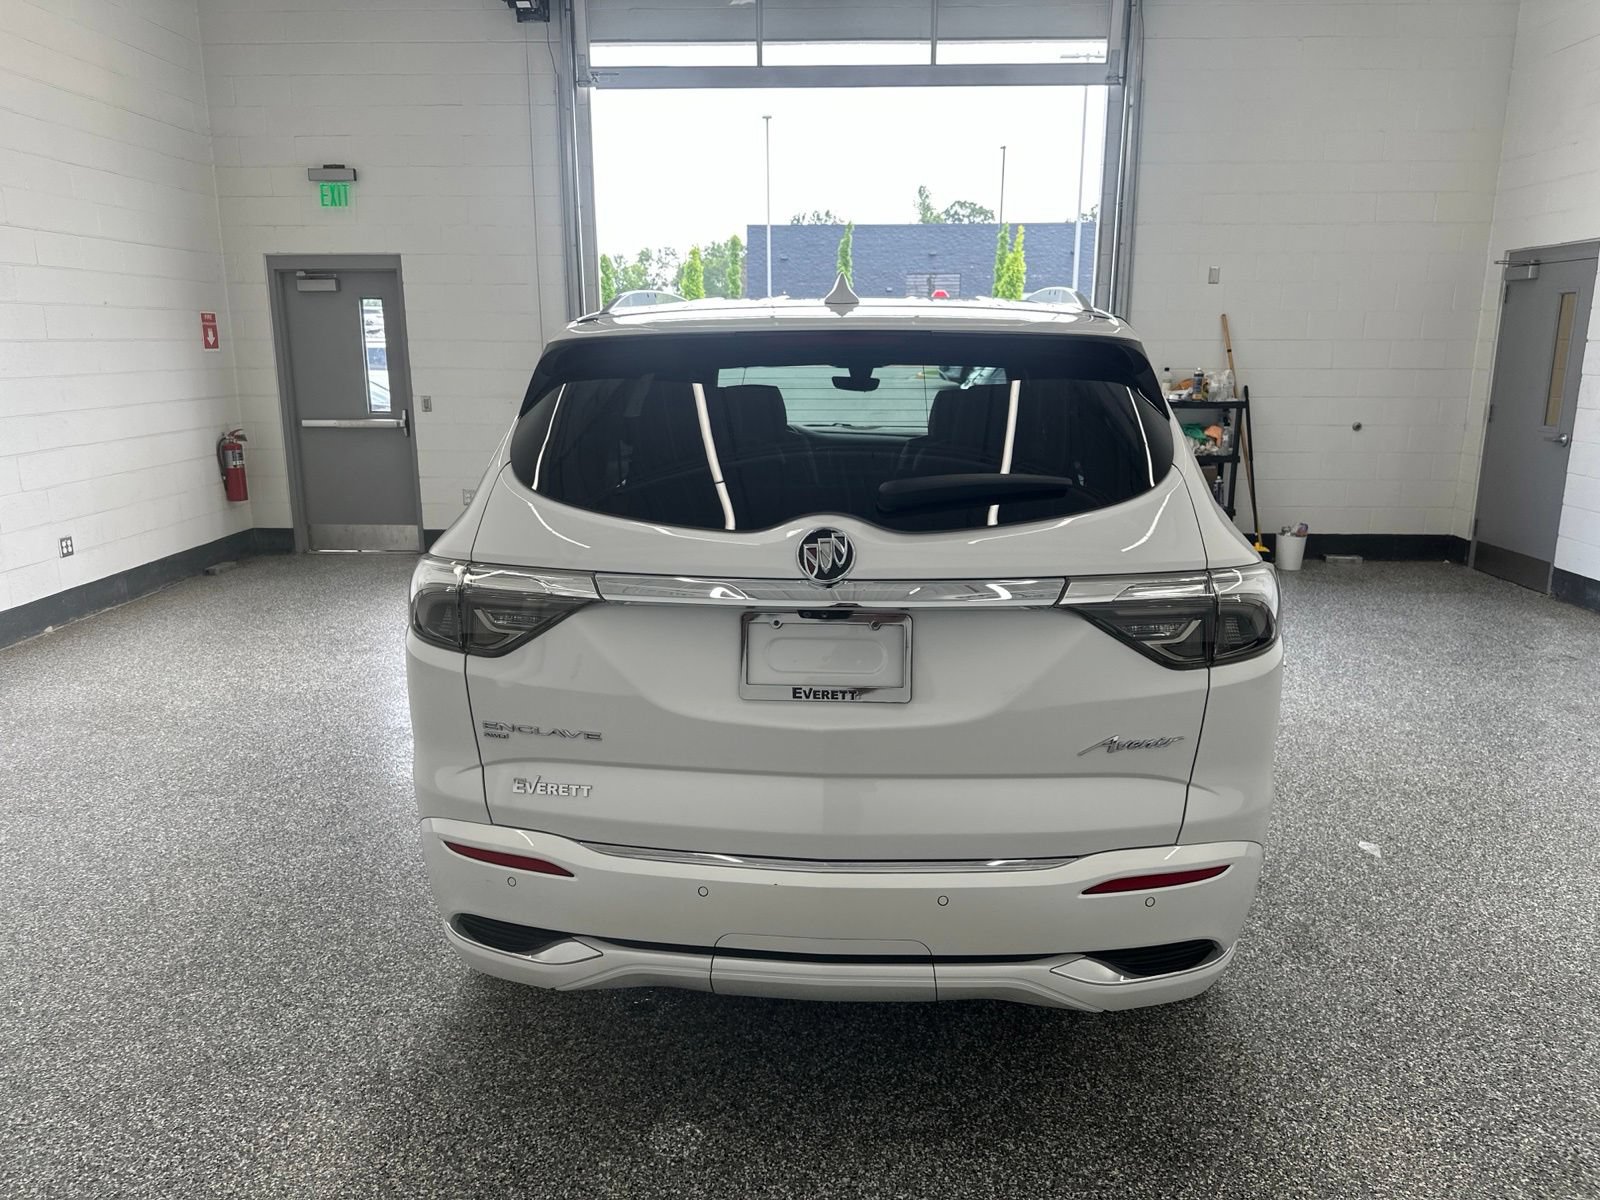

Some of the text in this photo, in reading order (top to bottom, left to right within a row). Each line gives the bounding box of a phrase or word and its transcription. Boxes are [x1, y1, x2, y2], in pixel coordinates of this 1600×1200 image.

[320, 183, 349, 207] EXIT
[792, 687, 857, 700] EVERETT
[482, 720, 602, 741] ENCLAVE
[512, 775, 593, 797] EVERETT
